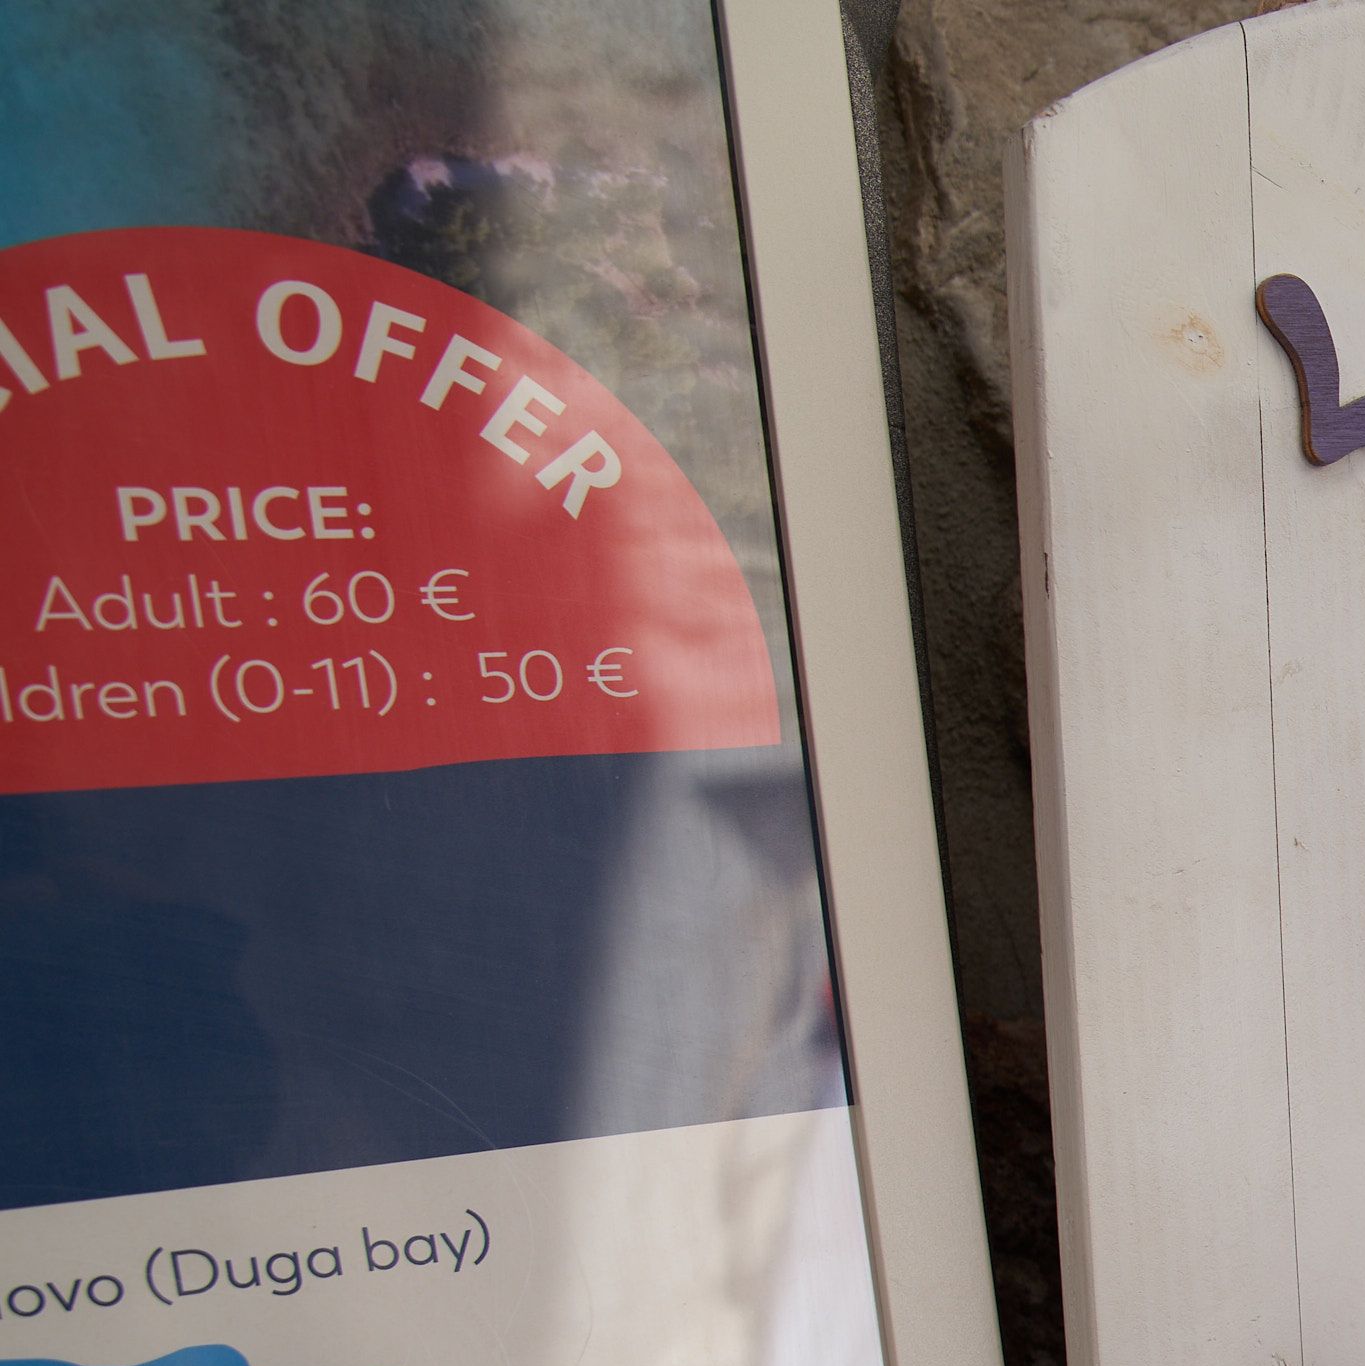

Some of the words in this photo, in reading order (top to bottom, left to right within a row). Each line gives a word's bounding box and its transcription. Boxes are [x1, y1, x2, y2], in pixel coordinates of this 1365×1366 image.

[0, 273, 207, 412] IAL
[257, 279, 622, 519] OFFER
[116, 485, 375, 542] PRICE:
[35, 573, 242, 631] Adult
[303, 570, 395, 626] 60
[420, 568, 476, 622] €
[211, 649, 398, 722] (0-11)
[479, 650, 563, 704] 50
[586, 646, 639, 699] €
[0, 1274, 125, 1320] ovo
[145, 1246, 343, 1305] (Duga
[362, 1208, 490, 1272] bay)
